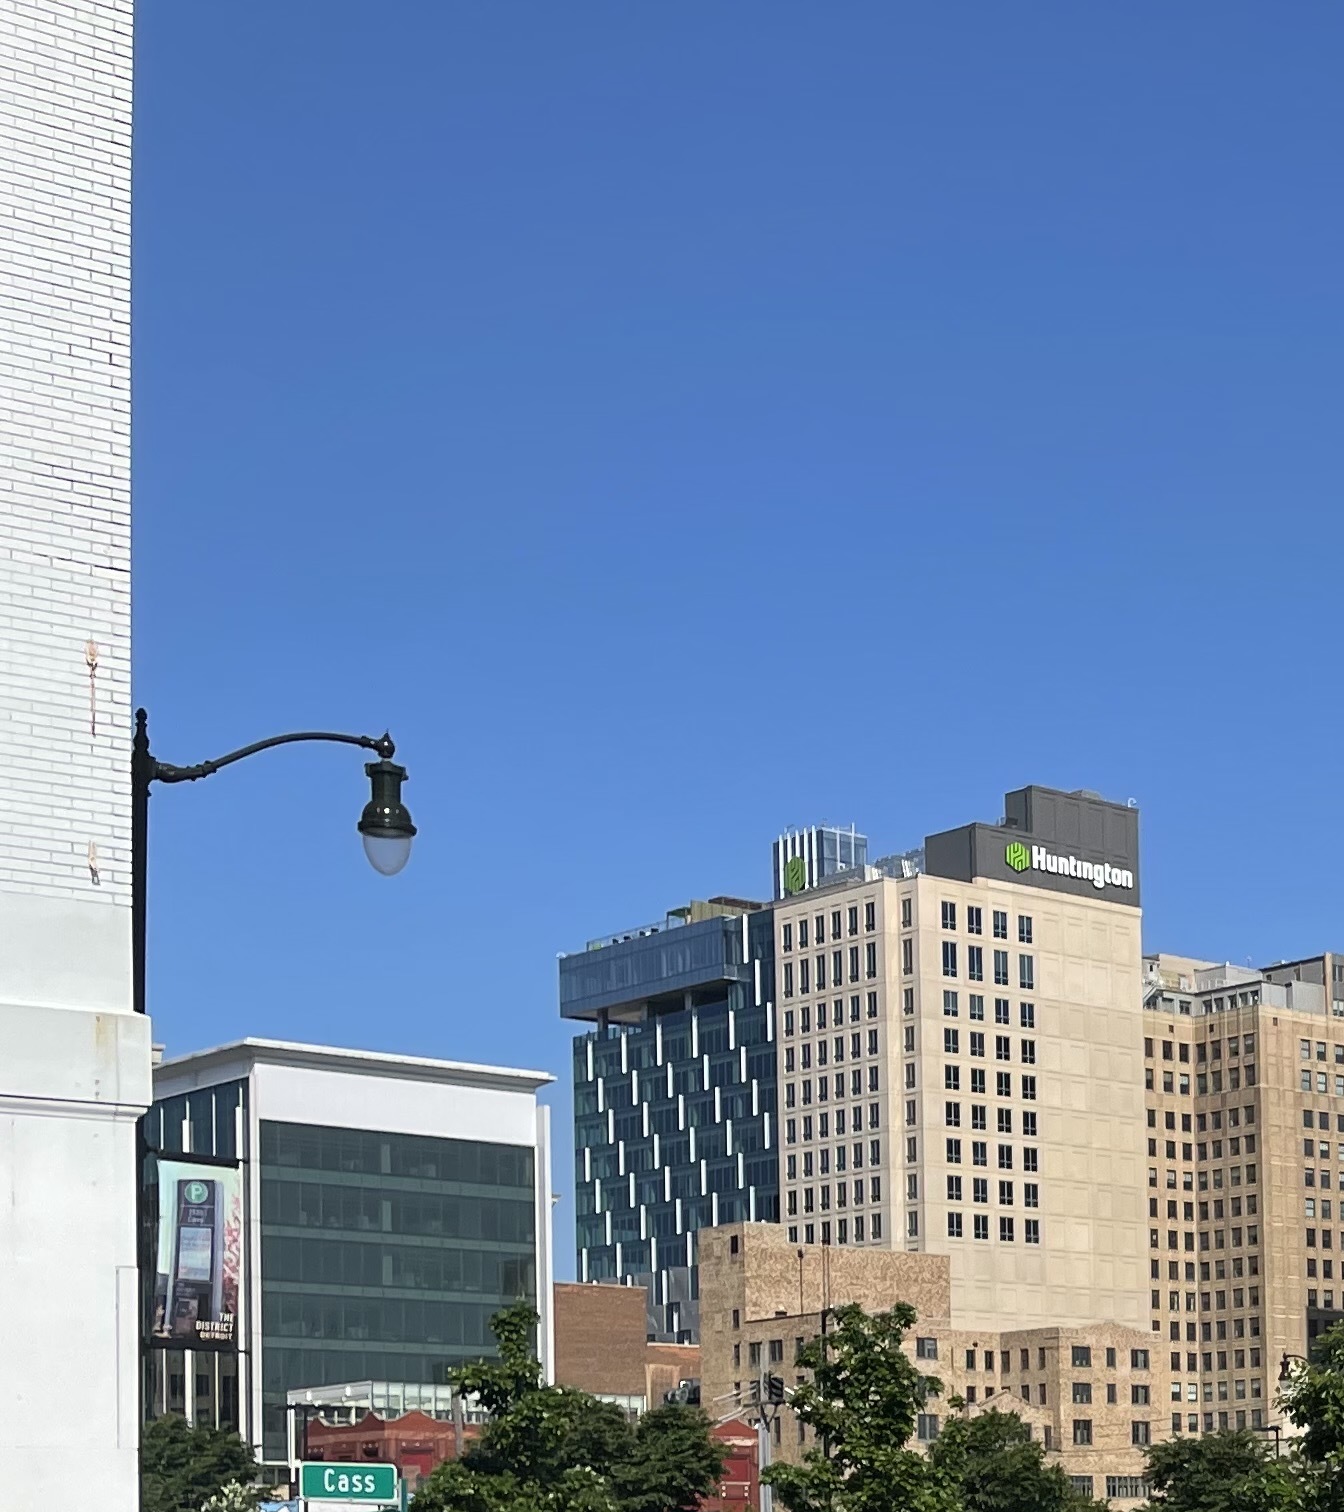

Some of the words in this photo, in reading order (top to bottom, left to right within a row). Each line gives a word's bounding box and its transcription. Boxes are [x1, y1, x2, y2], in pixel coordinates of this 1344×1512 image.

[1031, 845, 1133, 889] Huntington
[195, 1320, 234, 1333] DISTRICT
[324, 1468, 376, 1493] Cass
